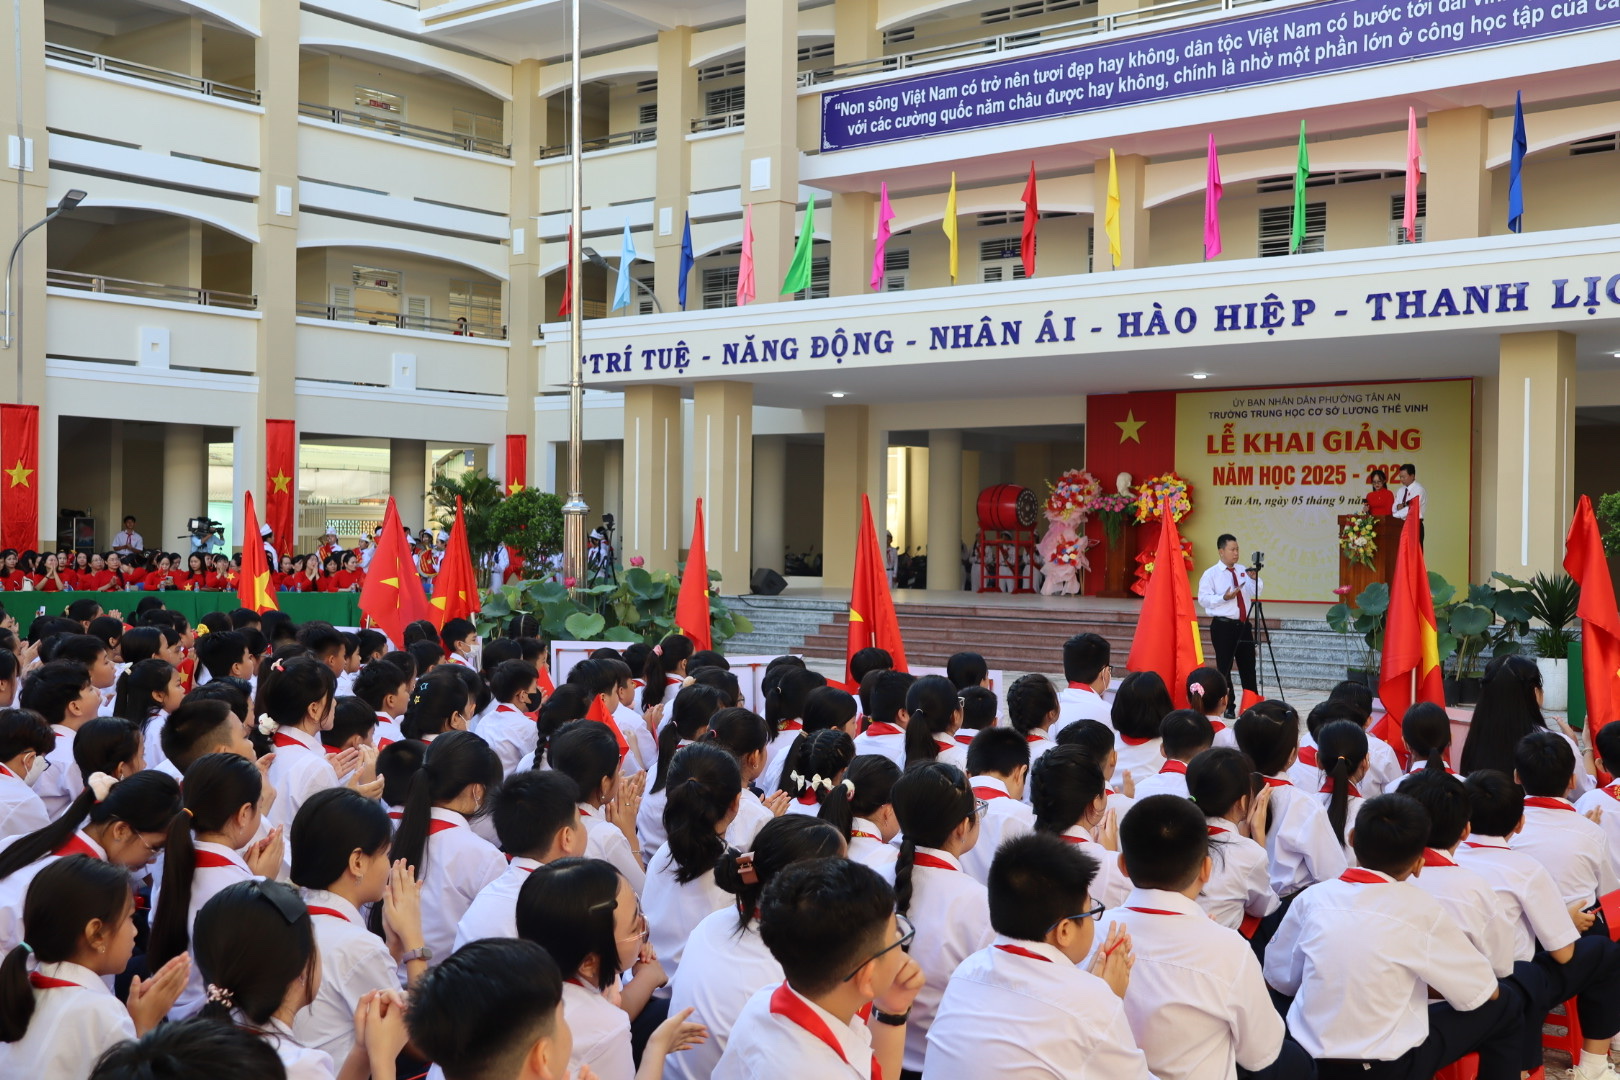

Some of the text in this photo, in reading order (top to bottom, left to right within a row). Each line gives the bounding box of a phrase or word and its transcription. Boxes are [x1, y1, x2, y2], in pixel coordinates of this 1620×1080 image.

[848, 119, 867, 135] với
[871, 116, 891, 132] các
[895, 111, 936, 128] cường
[940, 100, 972, 124] quốc
[977, 98, 1004, 115] năm
[1009, 92, 1041, 110] châu
[1046, 87, 1084, 105] được
[1089, 82, 1114, 99] hay
[1119, 73, 1169, 93] không,
[1174, 62, 1216, 84] chính
[1222, 57, 1235, 76] là
[1241, 51, 1273, 72] nhờ
[1278, 45, 1310, 67] một
[1315, 34, 1357, 64] phần
[1364, 32, 1392, 52] lớn
[1398, 27, 1413, 46] ở
[1418, 22, 1464, 42] công
[1471, 14, 1506, 36] học
[1513, 5, 1544, 29] tập
[868, 96, 898, 111] sông
[902, 89, 926, 107] Việt
[930, 86, 957, 101] Nam
[962, 79, 977, 96] có
[981, 75, 1001, 93] trở
[1005, 71, 1029, 89] nên
[1033, 64, 1063, 84] tươi
[1067, 62, 1094, 80] đẹp
[1098, 57, 1124, 74] hay
[1129, 48, 1179, 68] không,
[1184, 39, 1213, 58] dân
[1217, 34, 1242, 55] tộc
[1247, 26, 1279, 48] Việt
[1284, 22, 1321, 41] Nam
[1327, 12, 1348, 33] có
[1353, 4, 1402, 28] bước
[641, 340, 690, 374] TUỆ
[722, 335, 799, 365] NĂNG
[810, 328, 894, 363] ĐỘNG
[929, 316, 1022, 350] NHÂN
[1035, 311, 1076, 343] ÁI
[1117, 302, 1197, 337] HÀO
[1214, 293, 1316, 335] HIỆP
[1365, 282, 1529, 321] THANH
[1551, 274, 1620, 315] LỊC
[1209, 410, 1248, 420] TRƯỜNG
[1250, 409, 1283, 418] TRUNG
[1284, 408, 1305, 419] HỌC
[1308, 407, 1324, 416] CƠ
[1325, 406, 1340, 416] SỞ
[1342, 405, 1379, 415] LƯƠNG
[1404, 404, 1429, 413] VINH
[1247, 398, 1266, 407] BAN
[1268, 396, 1294, 406] NHÂN
[1296, 395, 1316, 405] DÂN
[1318, 394, 1363, 404] PHƯỜNG
[1365, 392, 1385, 402] TÂN
[1386, 393, 1401, 401] AN
[1206, 422, 1422, 454] LỄ KHAI GIẢNG
[1212, 462, 1254, 486] NĂM
[1259, 465, 1296, 490] HỌC
[1301, 464, 1347, 485] 2025
[1365, 464, 1402, 485] 202
[1224, 496, 1243, 505] Tân
[1244, 496, 1262, 507] An,
[1264, 496, 1289, 507] ngày
[1291, 495, 1304, 505] 05
[1306, 495, 1336, 507] tháng
[1338, 495, 1346, 505] 9
